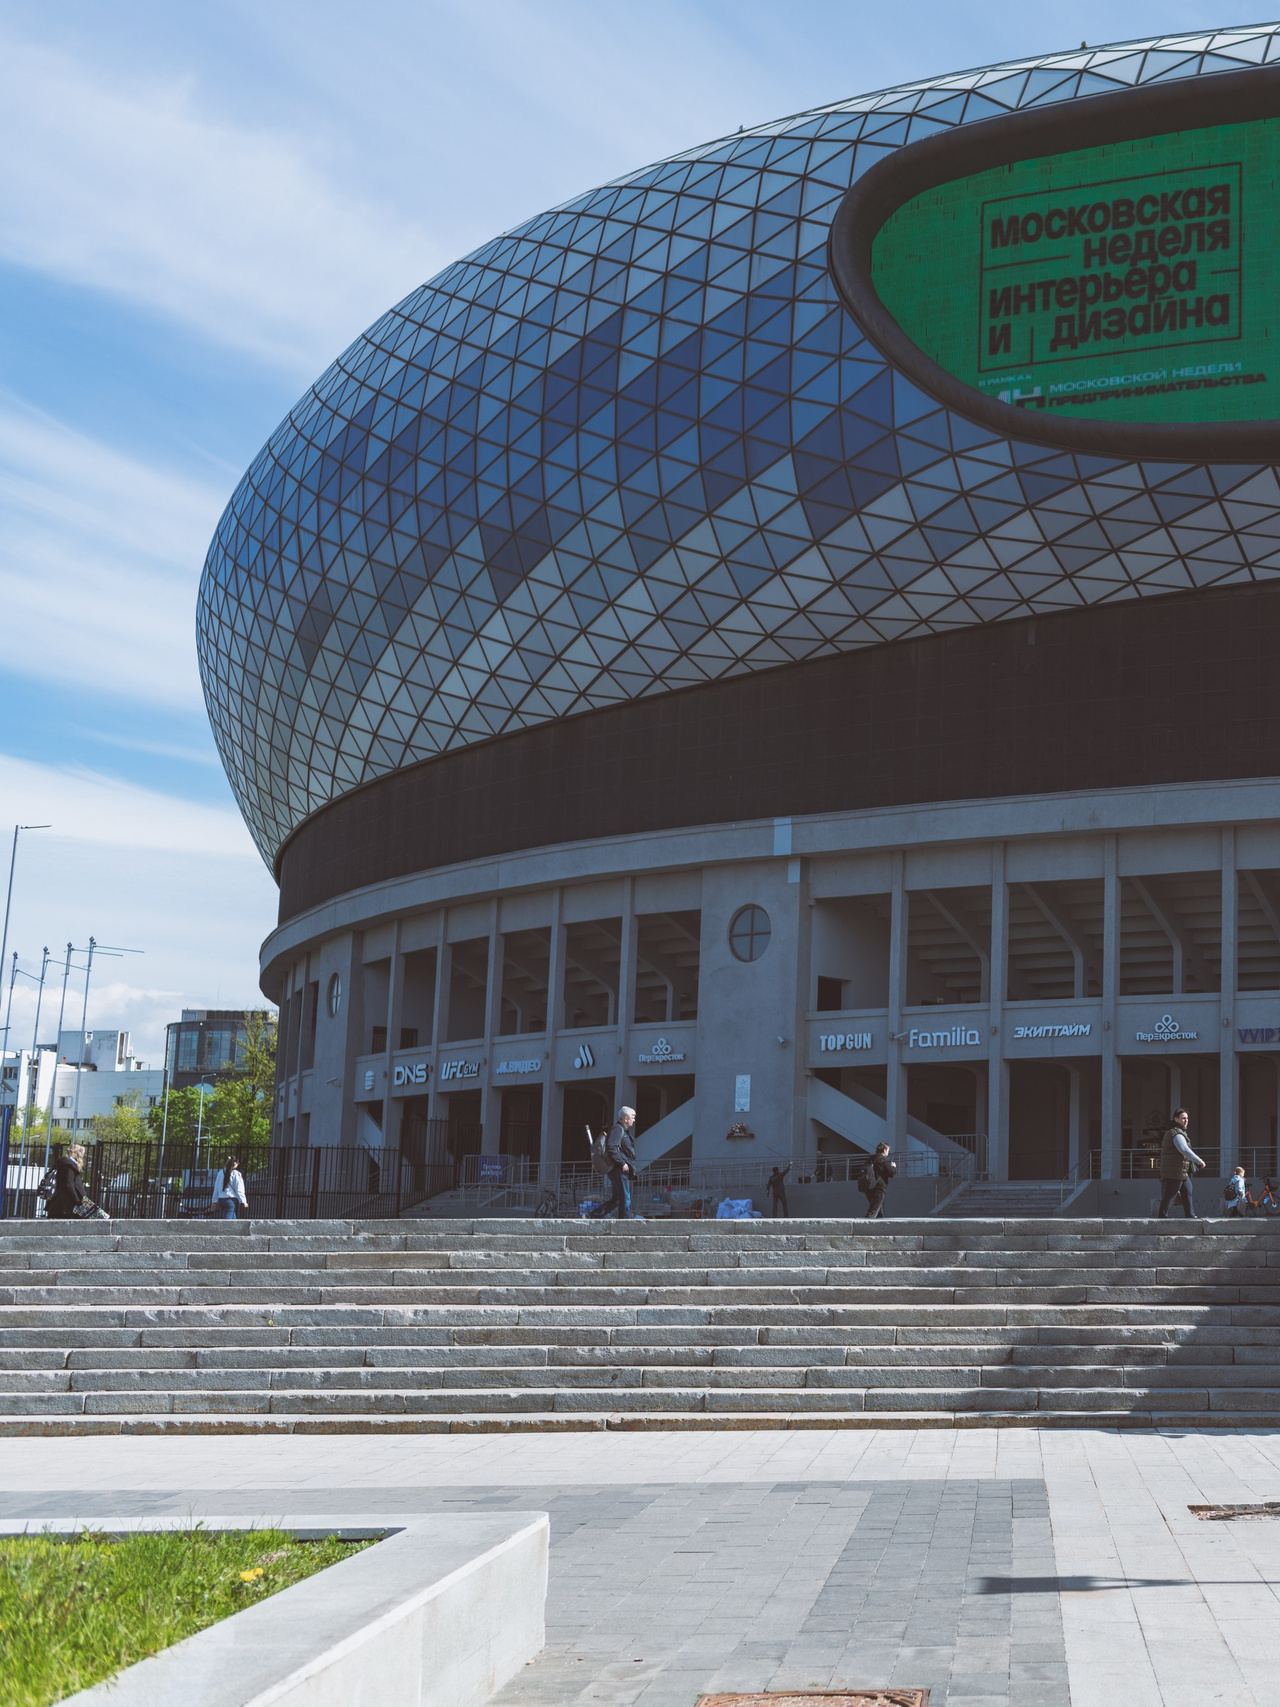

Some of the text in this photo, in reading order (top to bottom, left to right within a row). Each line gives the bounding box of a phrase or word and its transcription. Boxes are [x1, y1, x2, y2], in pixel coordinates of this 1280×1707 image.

[1083, 218, 1231, 269] неделя
[989, 259, 1197, 319] интерьера
[1049, 361, 1242, 393] МОСКОВСКОЙ НЕДЕЛИ
[1048, 373, 1268, 408] ПРЕДПРИНИМАТЕЛЬСТВА
[909, 1026, 981, 1048] Familia
[1013, 1023, 1091, 1039] ЭКИПТАЙМ
[1136, 1031, 1198, 1043] Перекресток
[1238, 1028, 1276, 1043] VVIP
[820, 1033, 872, 1051] TOPGUN
[638, 1053, 685, 1063] Перекресток
[394, 1063, 427, 1086] DNS
[441, 1060, 480, 1080] UFC GYM
